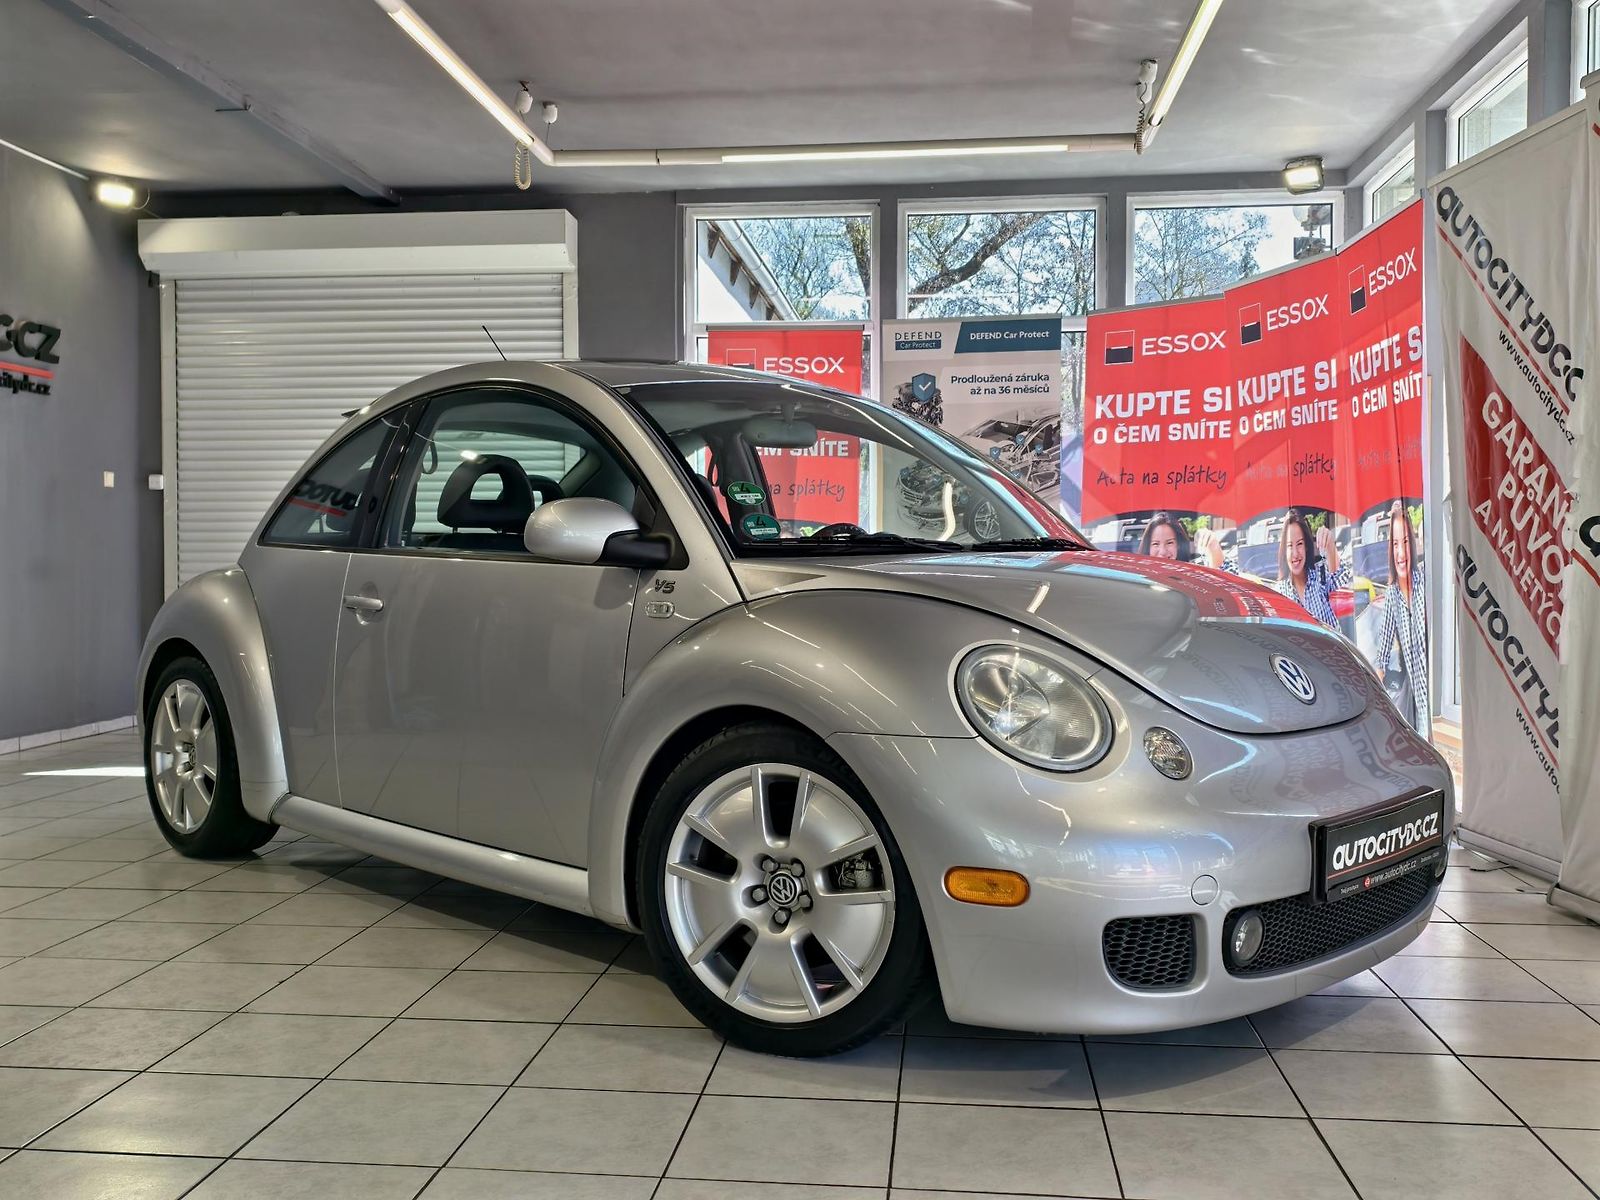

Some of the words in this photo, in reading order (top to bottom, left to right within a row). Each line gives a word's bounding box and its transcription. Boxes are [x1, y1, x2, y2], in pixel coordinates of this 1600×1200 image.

[1368, 247, 1417, 297] ESSOX
[1266, 294, 1329, 331] ESSOX
[895, 331, 942, 341] DEFEND
[912, 341, 936, 349] Protect
[970, 332, 1002, 340] DEFEND
[1003, 331, 1018, 339] Car
[1019, 331, 1049, 339] Protect
[1141, 330, 1227, 356] ESSOX
[763, 357, 845, 374] ESSOX
[1349, 333, 1402, 386] KUPTE
[951, 373, 1013, 384] Prodloužená
[1015, 373, 1050, 382] záruka
[970, 386, 982, 395] až
[999, 386, 1011, 395] 36
[1013, 383, 1050, 394] měsíců
[1237, 366, 1306, 407] KUPTE
[1314, 358, 1337, 391] SI
[1499, 330, 1575, 446] www.autocitydc.cz
[1094, 389, 1191, 420] KUPTE
[1203, 386, 1233, 413] SI
[1352, 395, 1359, 418] O
[1362, 387, 1388, 415] ČEM
[1393, 370, 1422, 405] SNÍT
[1093, 427, 1108, 445] O
[1114, 422, 1161, 443] ČEM
[1168, 418, 1232, 442] SNÍTE
[1239, 416, 1249, 436] O
[1253, 409, 1286, 433] ČEM
[1291, 398, 1338, 428] SNÍTE
[1142, 472, 1159, 485] na
[1166, 465, 1227, 491] splátky
[1293, 453, 1335, 483] splátky
[787, 478, 846, 503] splátky
[1497, 471, 1565, 584] PŮVO
[1474, 499, 1492, 525] A
[1491, 519, 1562, 637] NAJETÝC
